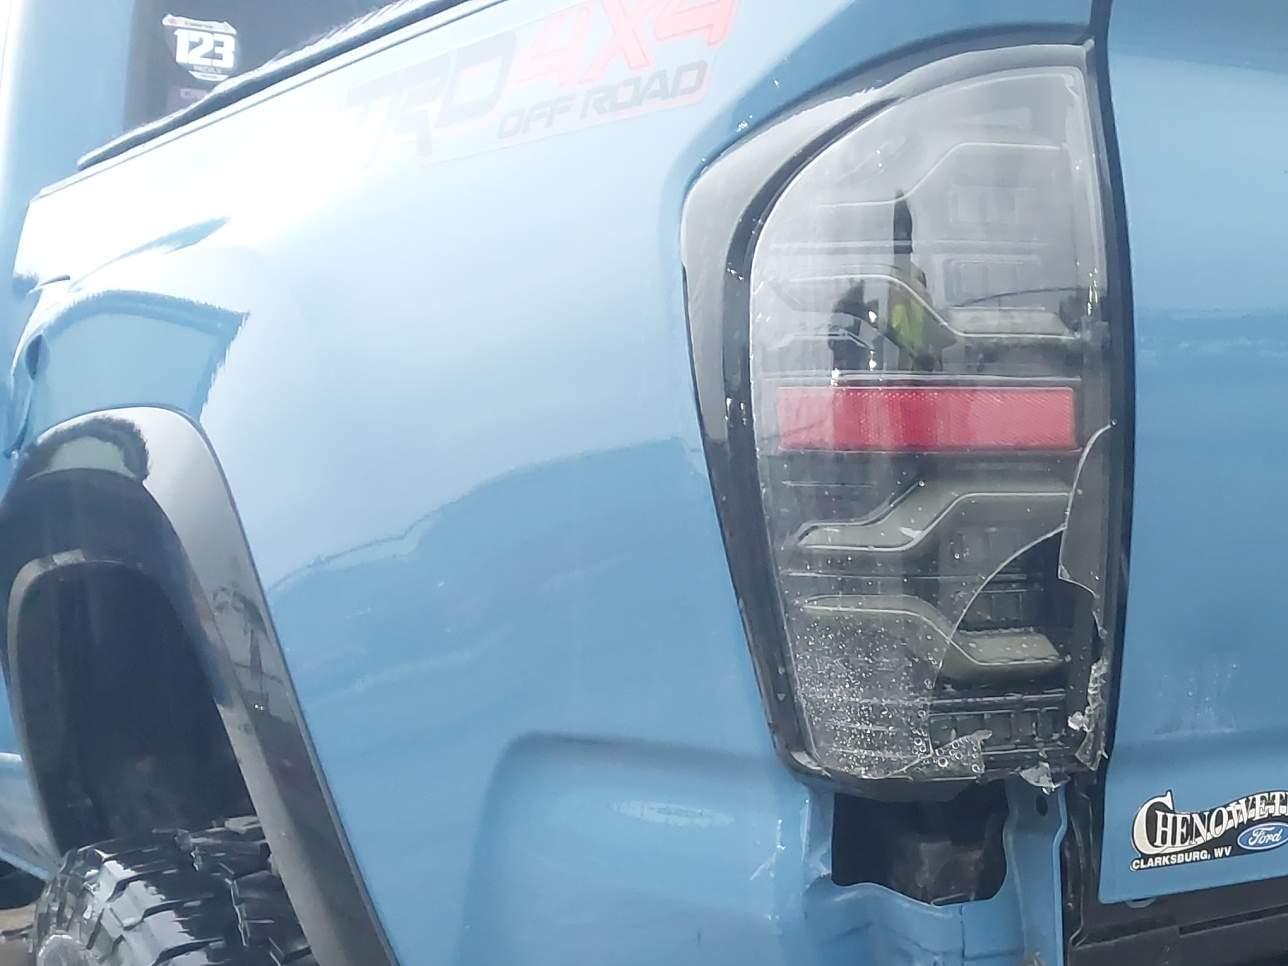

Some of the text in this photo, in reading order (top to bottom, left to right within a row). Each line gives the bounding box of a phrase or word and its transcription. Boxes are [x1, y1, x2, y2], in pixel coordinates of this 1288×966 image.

[174, 29, 235, 69] 123
[497, 59, 708, 140] OFF ROAD
[1248, 826, 1283, 846] Ford
[1213, 845, 1232, 858] WV
